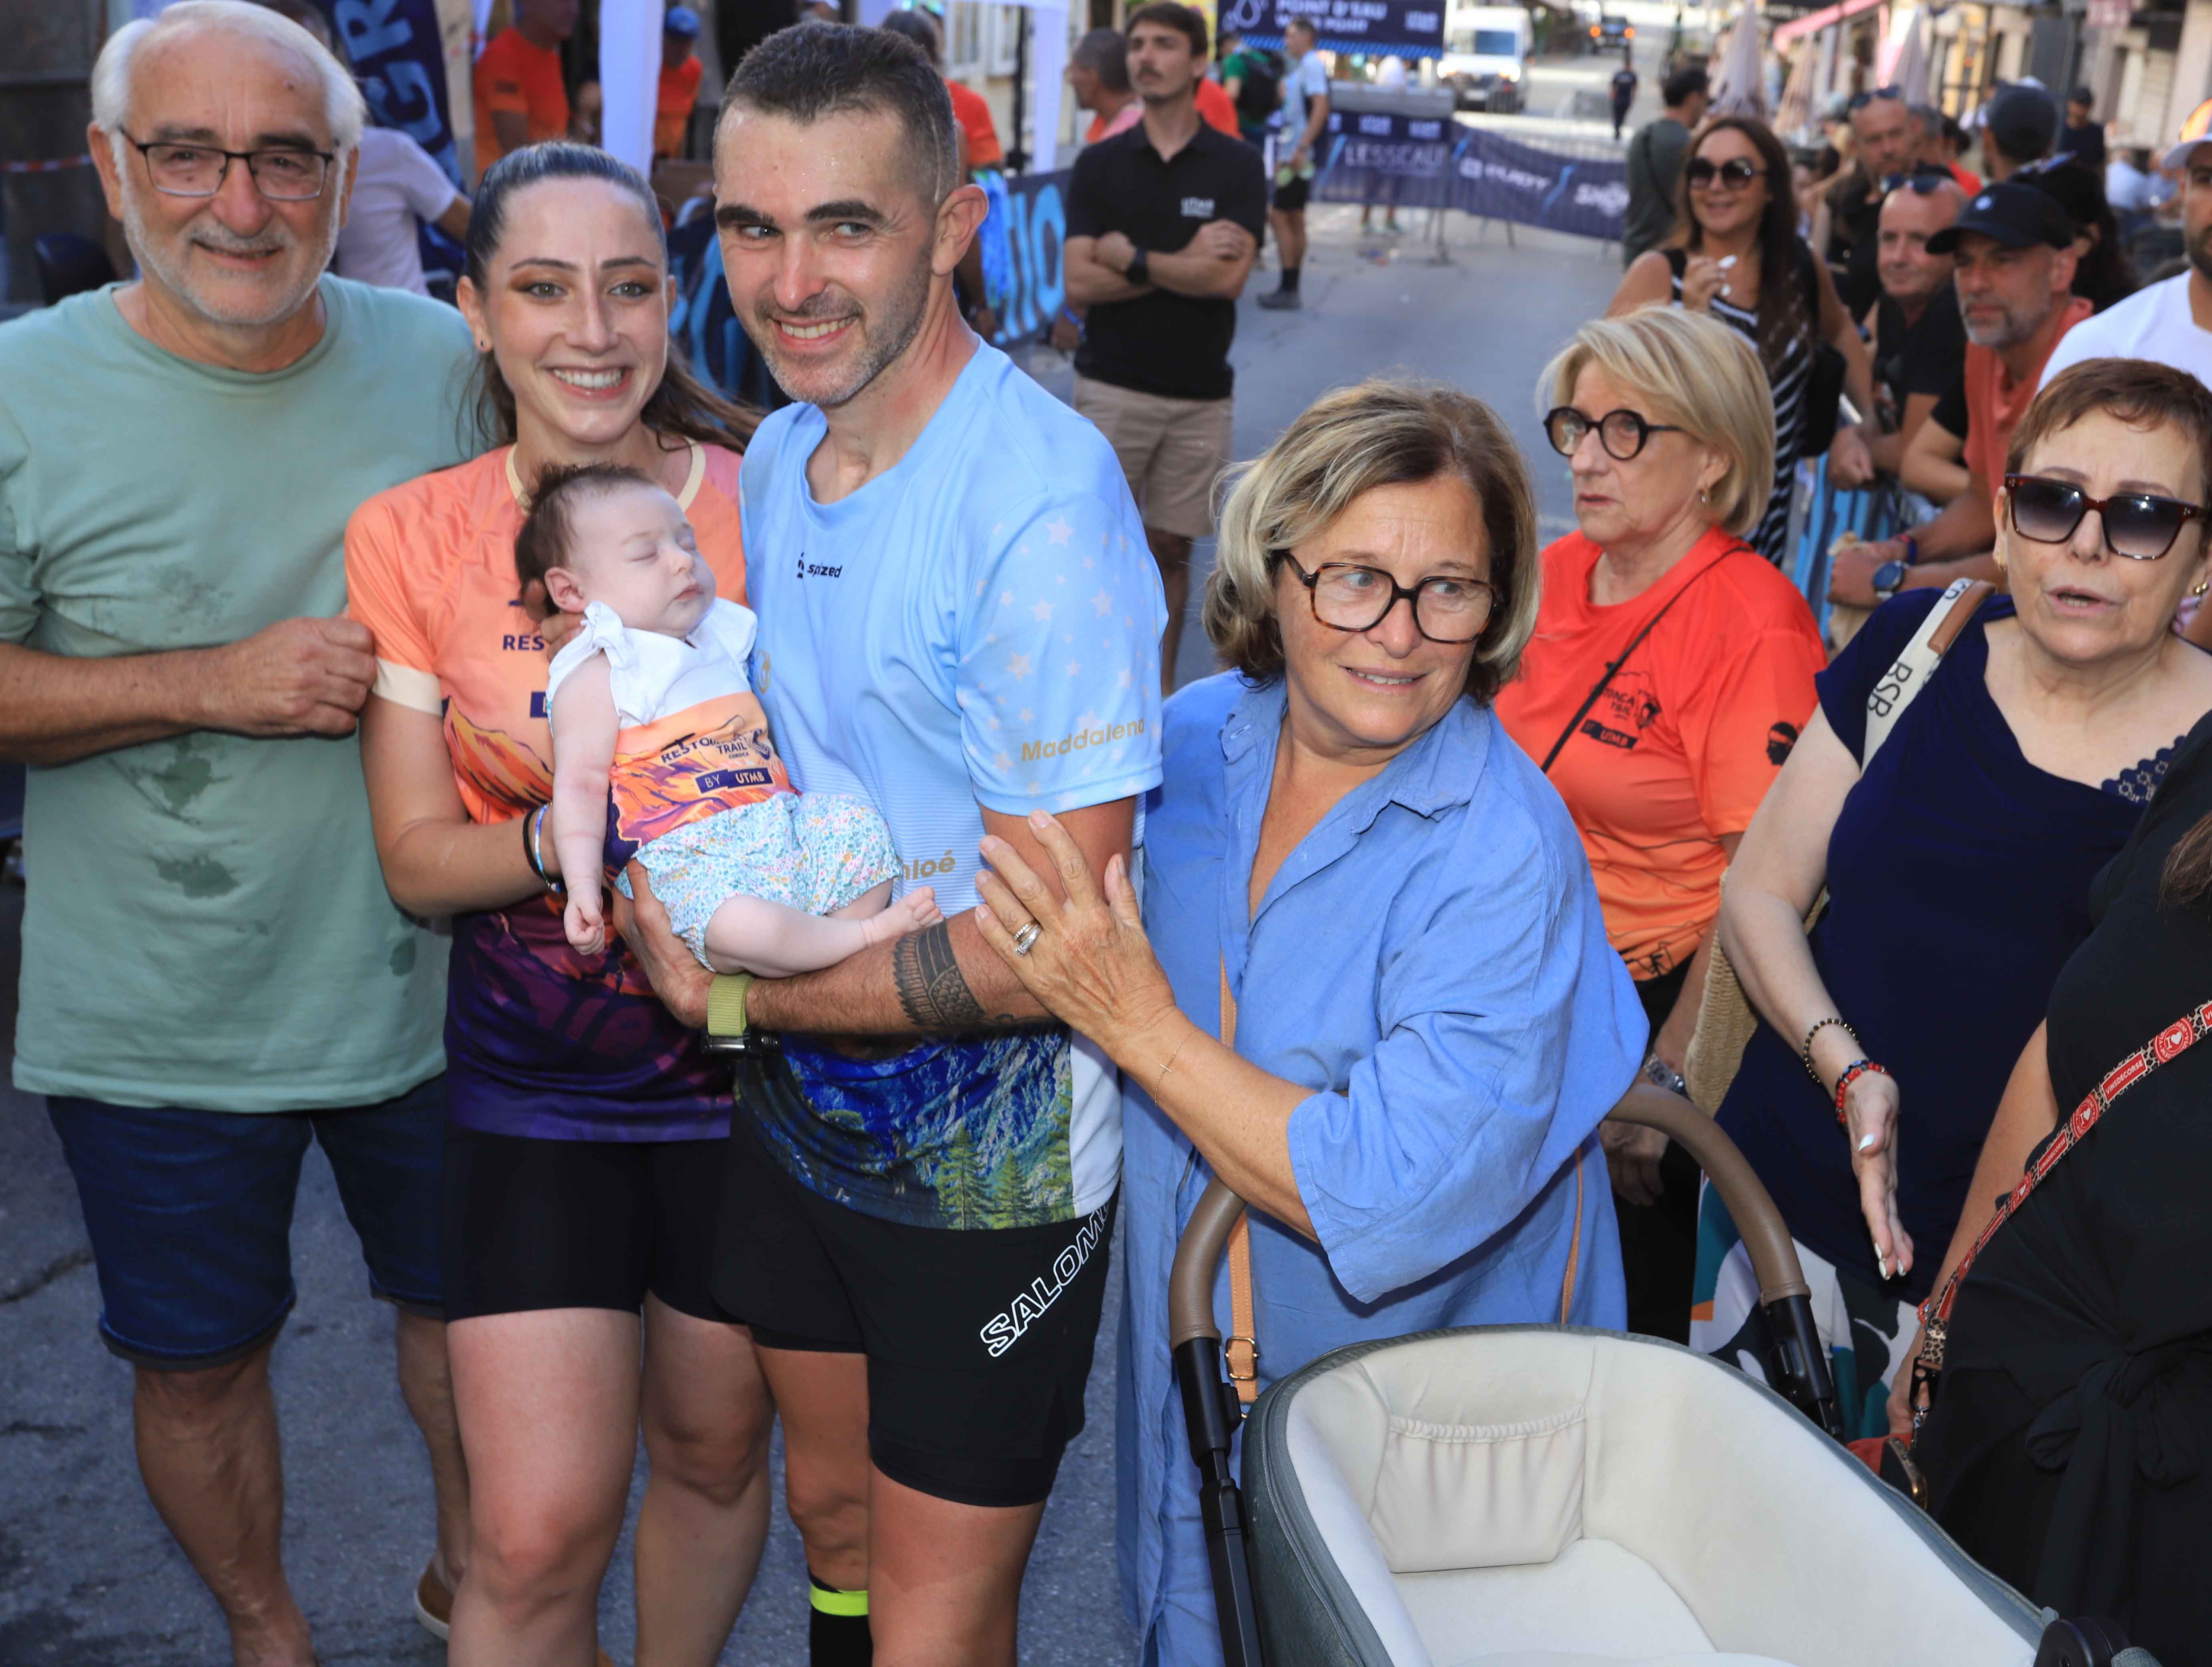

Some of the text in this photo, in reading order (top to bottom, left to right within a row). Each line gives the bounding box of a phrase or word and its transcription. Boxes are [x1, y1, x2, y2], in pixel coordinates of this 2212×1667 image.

[503, 635, 546, 651] RES
[716, 742, 747, 754] TRAIL
[704, 771, 765, 789] BY UTMB
[903, 849, 955, 880] hloé
[2105, 1059, 2144, 1095] VINSDECORSE
[980, 1202, 1109, 1358] SALOM
